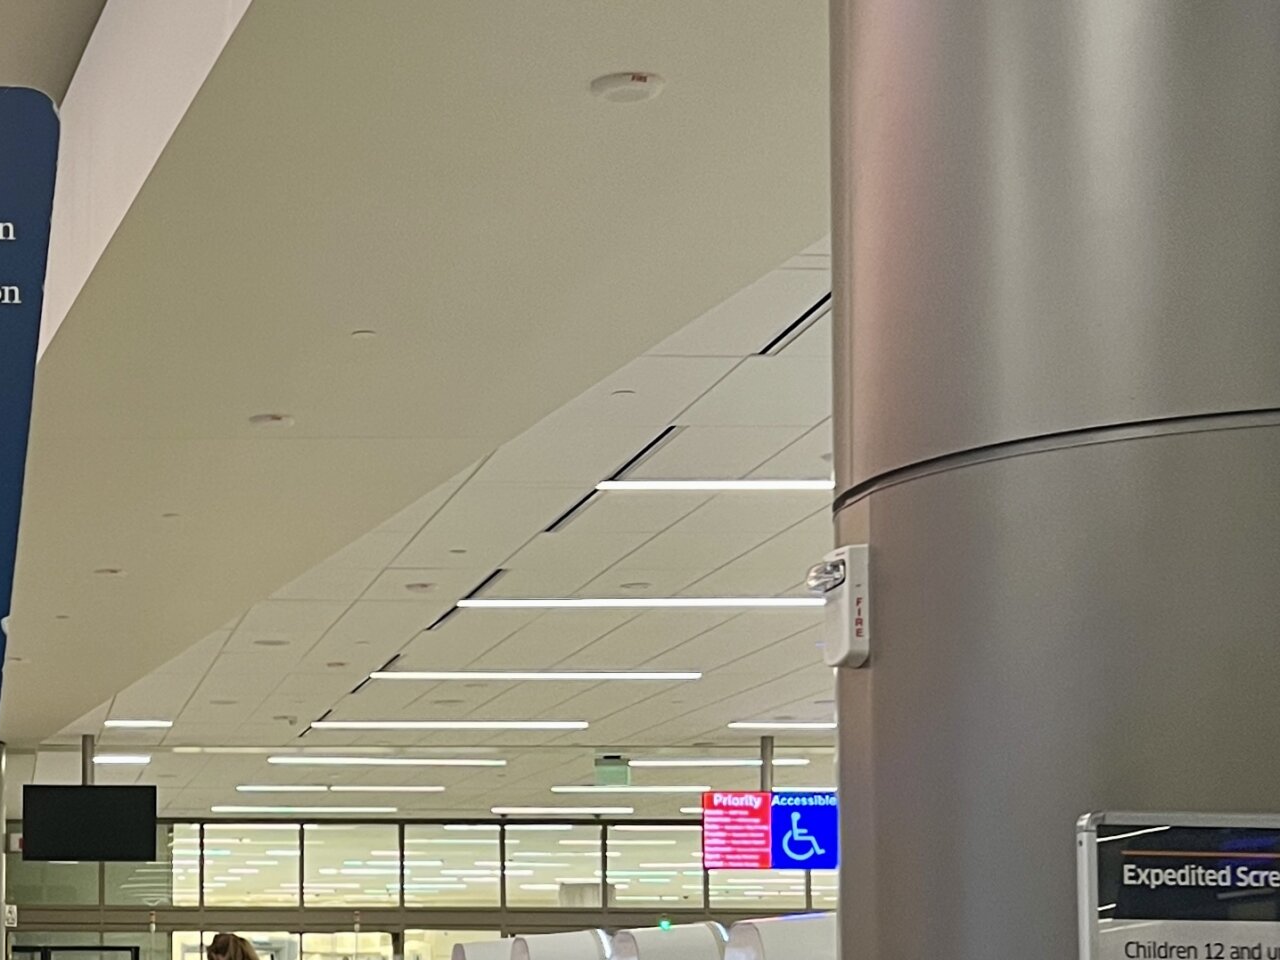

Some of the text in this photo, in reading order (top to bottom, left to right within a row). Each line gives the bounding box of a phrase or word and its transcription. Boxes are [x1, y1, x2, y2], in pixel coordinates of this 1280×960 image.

[855, 597, 864, 637] FIRE
[713, 792, 763, 809] Priority
[771, 795, 838, 806] Accessible
[1123, 864, 1280, 889] Expedited Scre
[1124, 941, 1198, 959] Children
[1205, 943, 1225, 960] 12
[1230, 942, 1262, 960] and
